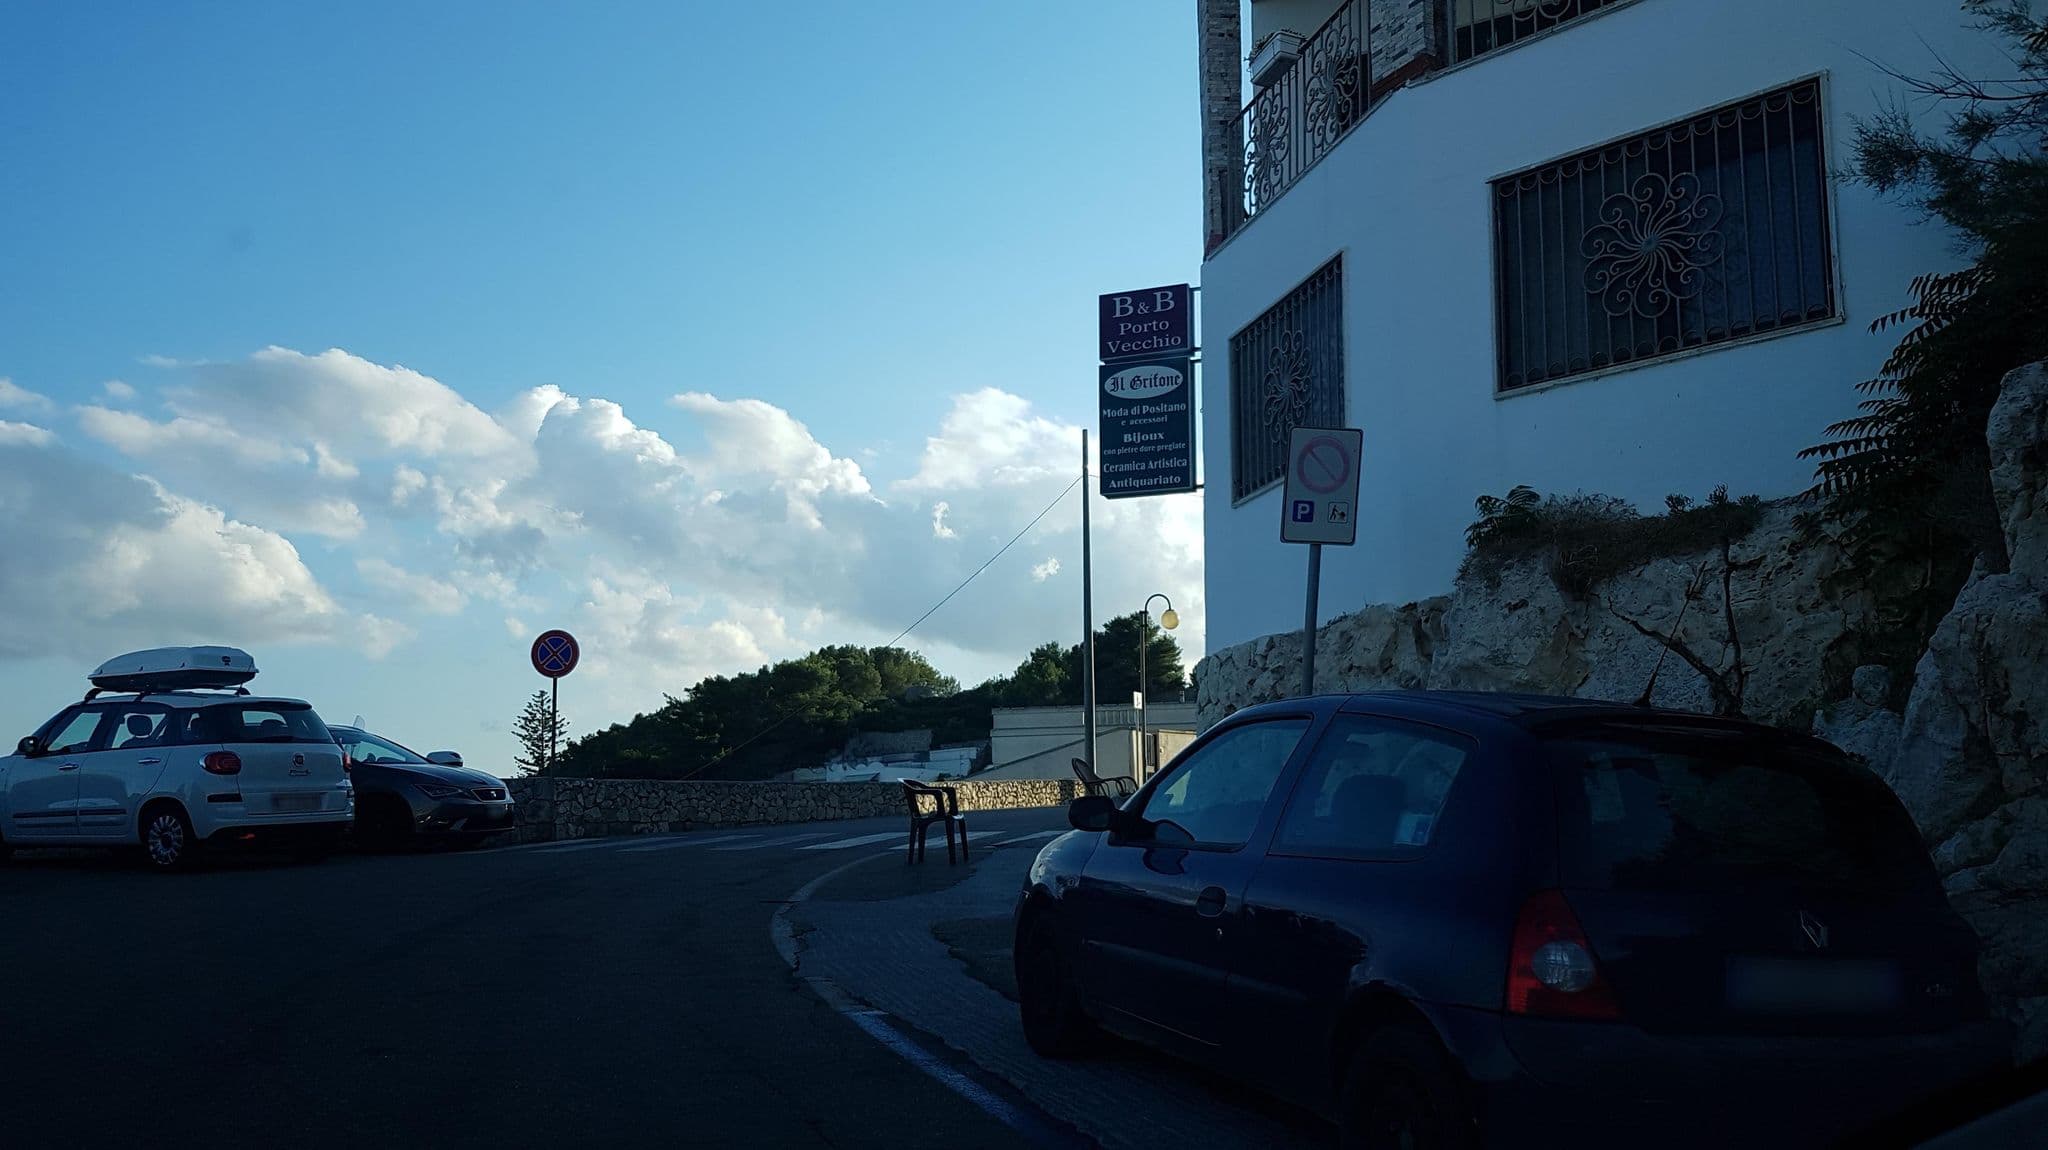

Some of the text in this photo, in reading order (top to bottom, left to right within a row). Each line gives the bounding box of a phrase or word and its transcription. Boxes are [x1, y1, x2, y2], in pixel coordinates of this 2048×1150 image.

[1112, 291, 1175, 318] B & B
[1119, 320, 1169, 335] Porto
[1106, 334, 1181, 353] Vecchio
[1109, 373, 1181, 392] Il Grifone
[1102, 403, 1186, 418] Moda di Positano
[1129, 415, 1168, 425] accessori
[1123, 432, 1165, 444] Bijoux
[1117, 446, 1138, 455] pietre
[1156, 442, 1186, 452] pregiate
[1103, 457, 1188, 473] Ceramica Artistica
[1109, 475, 1181, 488] Antiquariato
[1297, 503, 1310, 519] P
